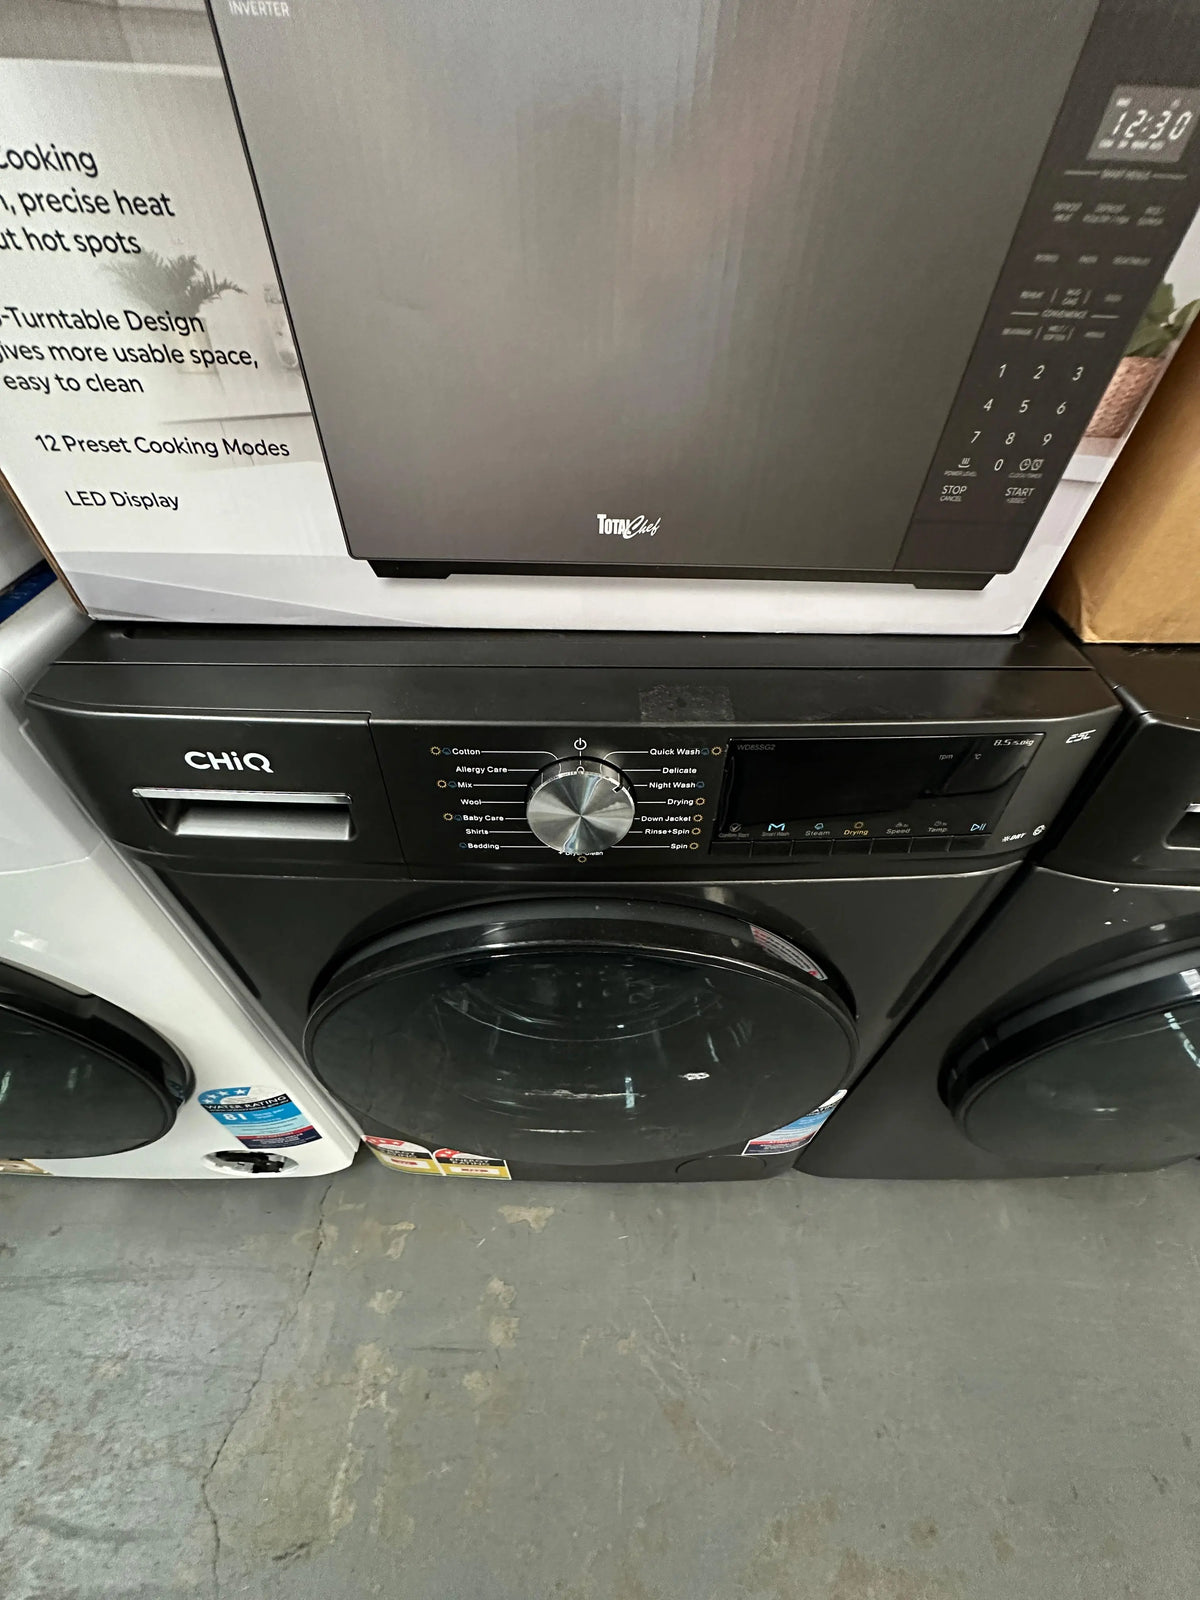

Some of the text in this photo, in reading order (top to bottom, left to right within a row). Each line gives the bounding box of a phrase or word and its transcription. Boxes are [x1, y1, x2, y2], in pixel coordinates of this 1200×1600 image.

[228, 0, 290, 16] INVERTER
[1112, 109, 1193, 140] 12:30
[18, 187, 110, 217] precise
[113, 189, 176, 217] heat
[22, 227, 71, 251] hot
[73, 232, 142, 257] spots
[123, 310, 205, 336] Design
[48, 345, 109, 362] more
[115, 344, 184, 364] usable
[189, 349, 258, 368] space,
[999, 364, 1084, 381] 1 2 3
[3, 373, 144, 395] easy to clean
[983, 398, 1067, 415] 4 5 6
[35, 435, 290, 458] 12 Preset Cooking Modes
[971, 431, 1053, 446] 7 8 9
[994, 459, 1004, 471] 0
[942, 485, 967, 494] STOP
[1005, 487, 1035, 496] START
[65, 490, 179, 511] LED Display
[650, 748, 700, 756] Quick Wash
[184, 751, 274, 773] CHiQ
[455, 766, 485, 774] Allergy
[649, 782, 671, 790] Night
[667, 799, 694, 807] Drying
[463, 815, 483, 823] Baby
[245, 1096, 287, 1108] RATING
